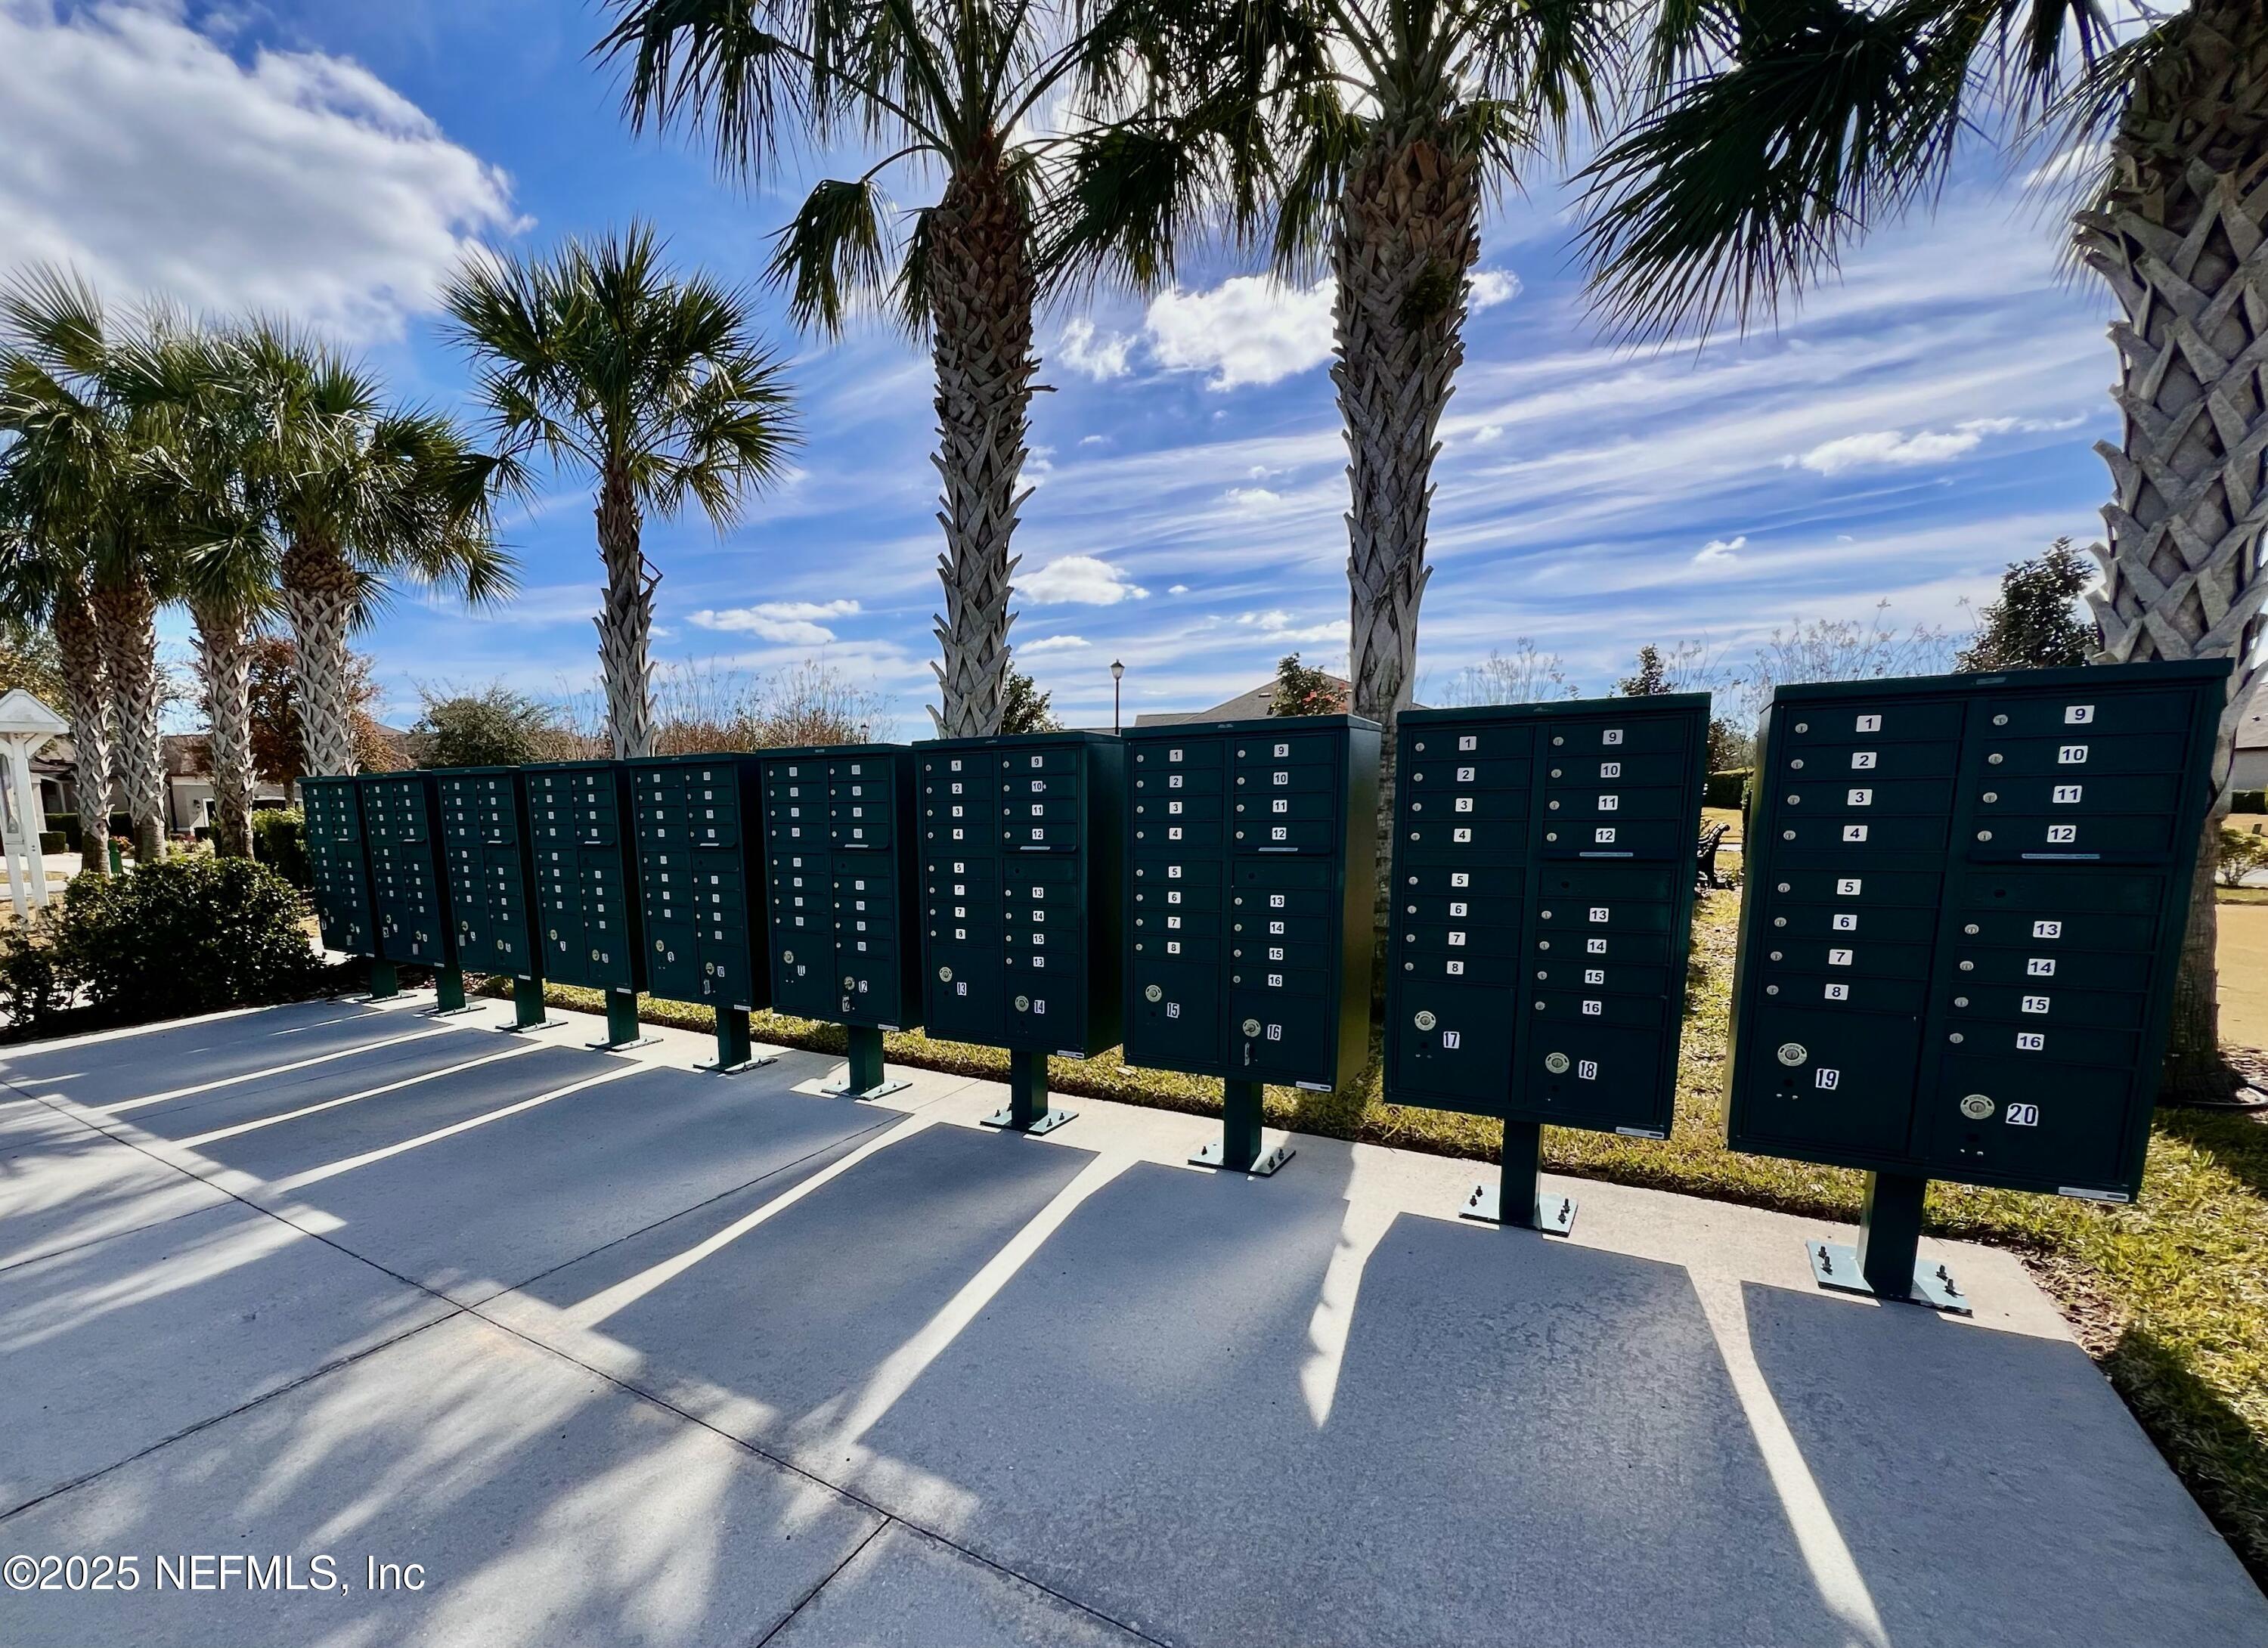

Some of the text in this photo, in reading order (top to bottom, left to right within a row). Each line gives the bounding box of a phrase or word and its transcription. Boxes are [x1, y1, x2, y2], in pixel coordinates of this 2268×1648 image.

[2074, 708, 2086, 720] 9
[1865, 717, 1873, 730] 1
[1609, 732, 1617, 742] 9
[1465, 738, 1470, 748] 1
[1174, 751, 1179, 760] 1
[1278, 746, 1284, 755] 9
[2062, 748, 2084, 761] 10
[1859, 754, 1870, 767] 2
[1462, 770, 1470, 779] 2
[1603, 765, 1619, 776] 10
[1173, 777, 1179, 786] 2
[1275, 774, 1287, 783] 10
[1033, 782, 1042, 791] 10
[1855, 791, 1864, 803] 3
[2058, 788, 2078, 801] 11
[1173, 804, 1179, 812] 3
[1275, 801, 1285, 810] 11
[1461, 800, 1467, 810] 3
[1601, 798, 1616, 808] 11
[1033, 806, 1042, 814] 11
[1033, 830, 1043, 838] 12
[1172, 829, 1179, 838] 4
[1273, 829, 1285, 838] 12
[1458, 830, 1466, 840] 4
[1597, 830, 1613, 841] 12
[1850, 828, 1860, 839] 4
[2050, 828, 2073, 840] 12
[1172, 868, 1178, 876] 5
[1456, 875, 1464, 885] 5
[1844, 881, 1854, 893] 5
[1033, 888, 1043, 897] 13
[1171, 894, 1177, 902] 6
[1272, 897, 1283, 906] 13
[1455, 905, 1462, 915] 6
[1591, 909, 1606, 920] 13
[1171, 918, 1177, 927] 7
[1840, 916, 1850, 928] 6
[1271, 923, 1283, 932] 14
[2037, 923, 2058, 936] 13
[1454, 934, 1461, 943] 7
[1171, 943, 1176, 952] 8
[1589, 941, 1604, 952] 14
[1270, 949, 1282, 959] 15
[1836, 952, 1846, 962] 7
[1452, 962, 1459, 972] 8
[2031, 961, 2052, 974] 14
[1269, 976, 1281, 985] 16
[1587, 971, 1602, 982] 15
[959, 984, 965, 994] 13
[1832, 987, 1841, 998] 8
[1036, 1002, 1043, 1012] 14
[1585, 1002, 1600, 1013] 16
[2025, 998, 2047, 1011] 15
[1169, 1004, 1177, 1016] 15
[1269, 1026, 1279, 1039] 16
[1445, 1033, 1458, 1046] 17
[2019, 1036, 2042, 1048] 16
[1582, 1062, 1594, 1077] 18
[1818, 1070, 1836, 1087] 19
[2008, 1105, 2036, 1124] 20
